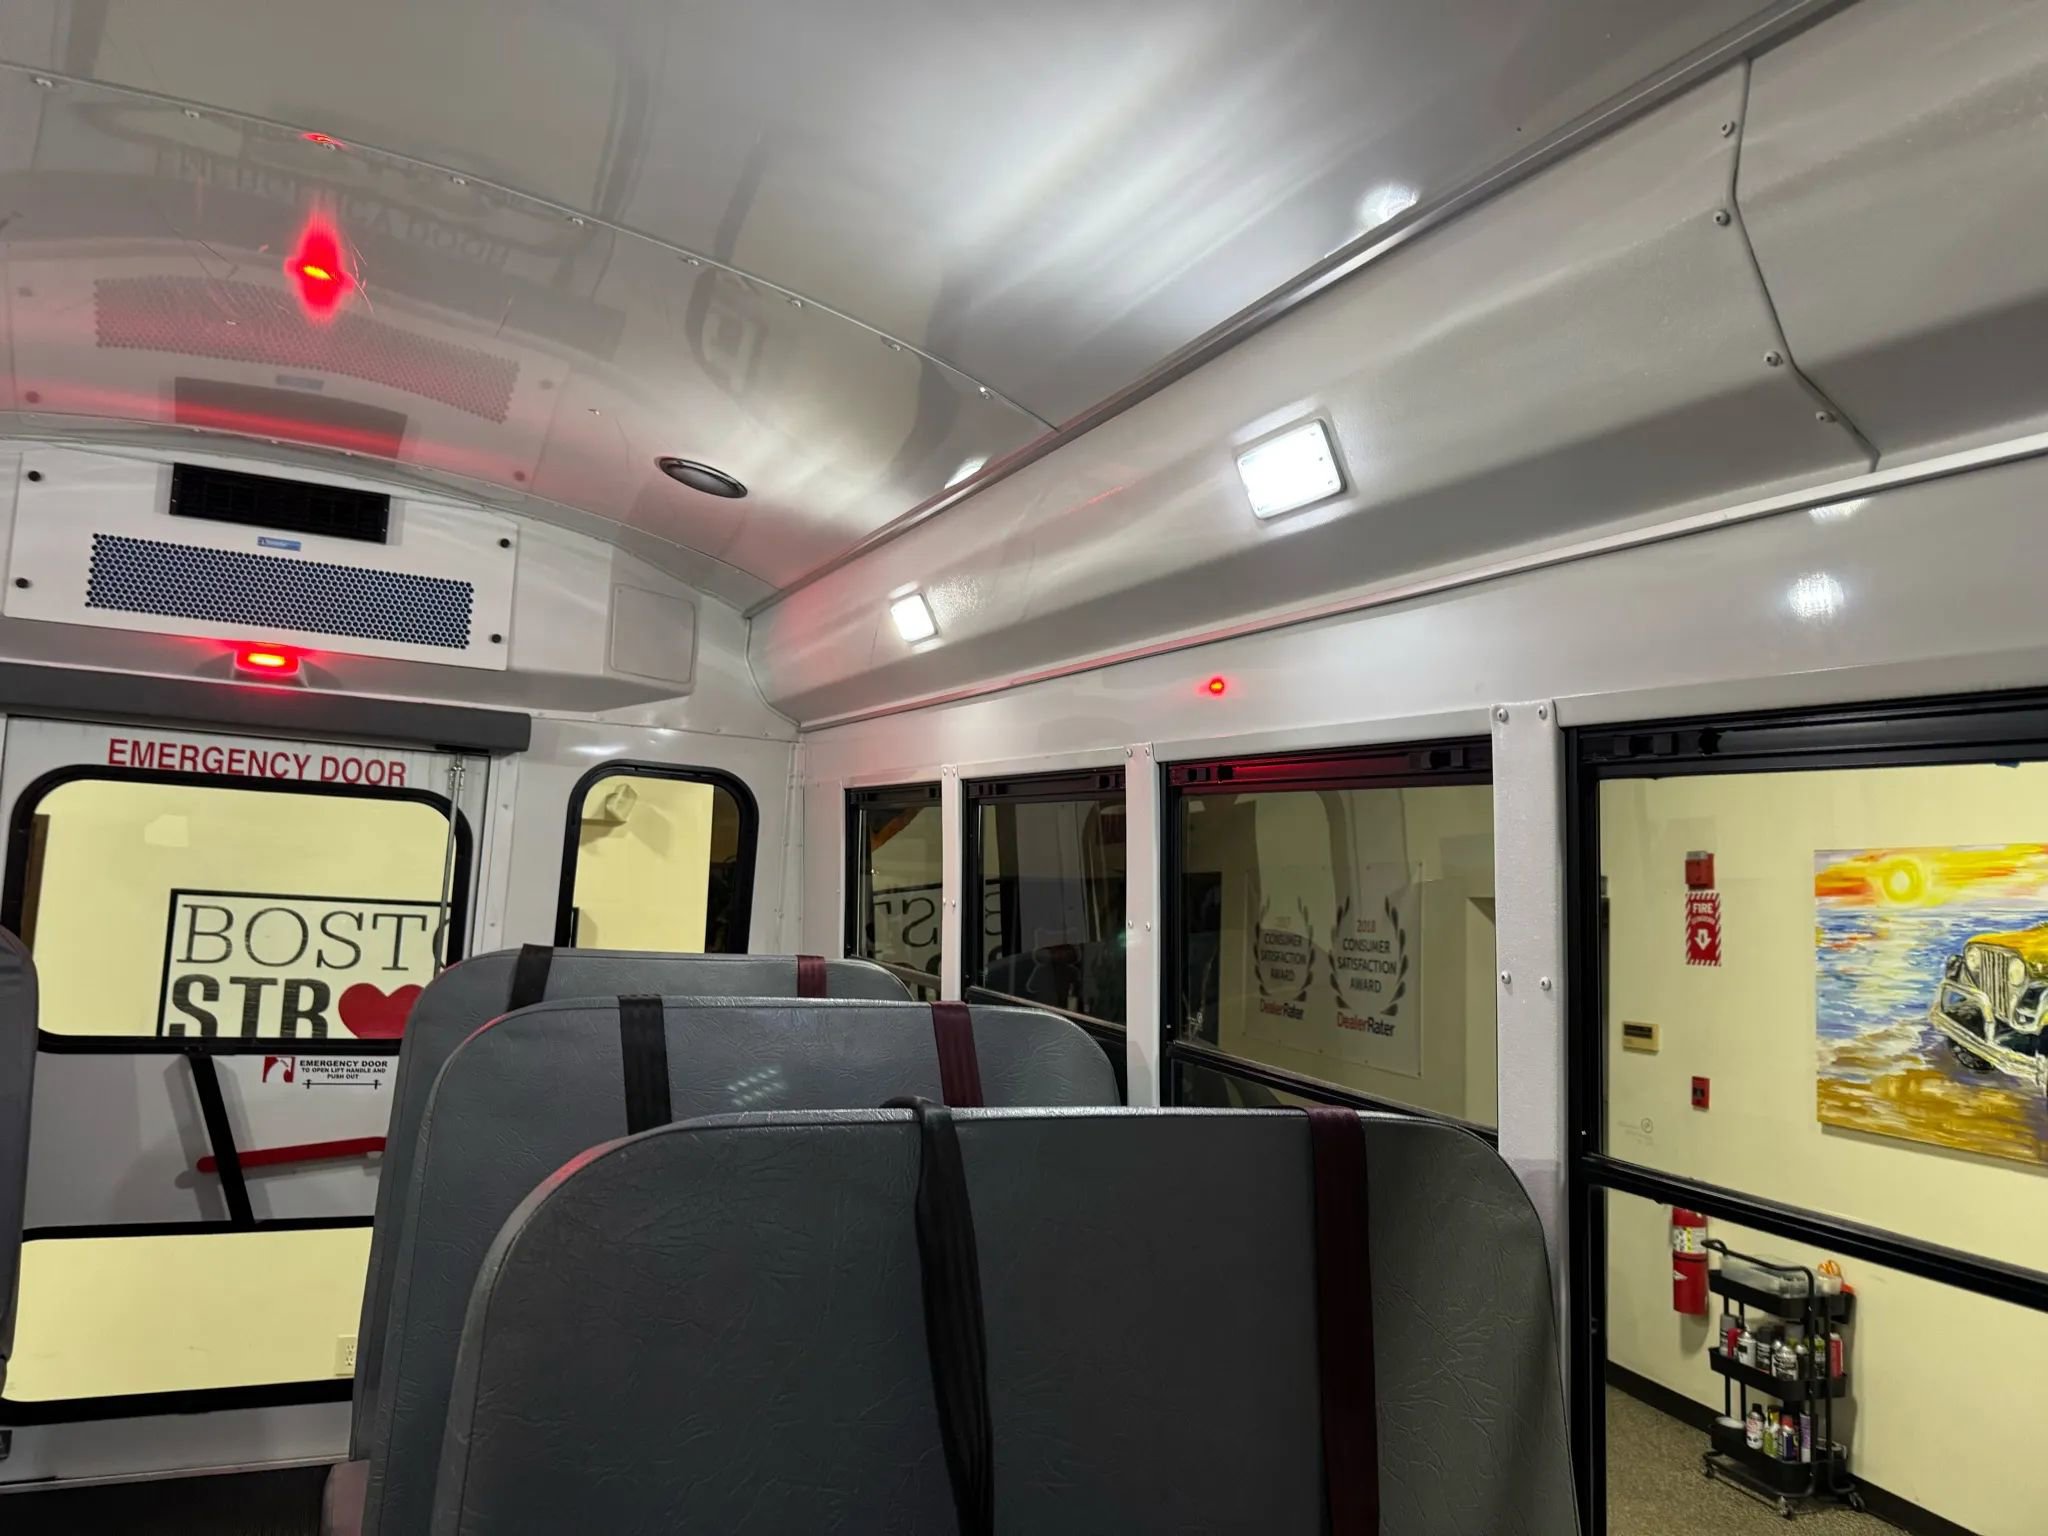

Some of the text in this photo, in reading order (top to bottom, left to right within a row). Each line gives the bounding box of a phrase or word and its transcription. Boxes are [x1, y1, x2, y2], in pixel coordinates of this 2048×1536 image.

[107, 738, 407, 787] EMERGENCY DOOR
[1692, 902, 1714, 914] FIRE
[1264, 932, 1303, 947] CONSUMER
[1342, 938, 1392, 954] CONSUMER
[1337, 956, 1397, 976] SATISFACTION
[1270, 967, 1295, 982] AWARD
[1350, 977, 1382, 993] AWARD
[1337, 1010, 1397, 1037] DealerRater
